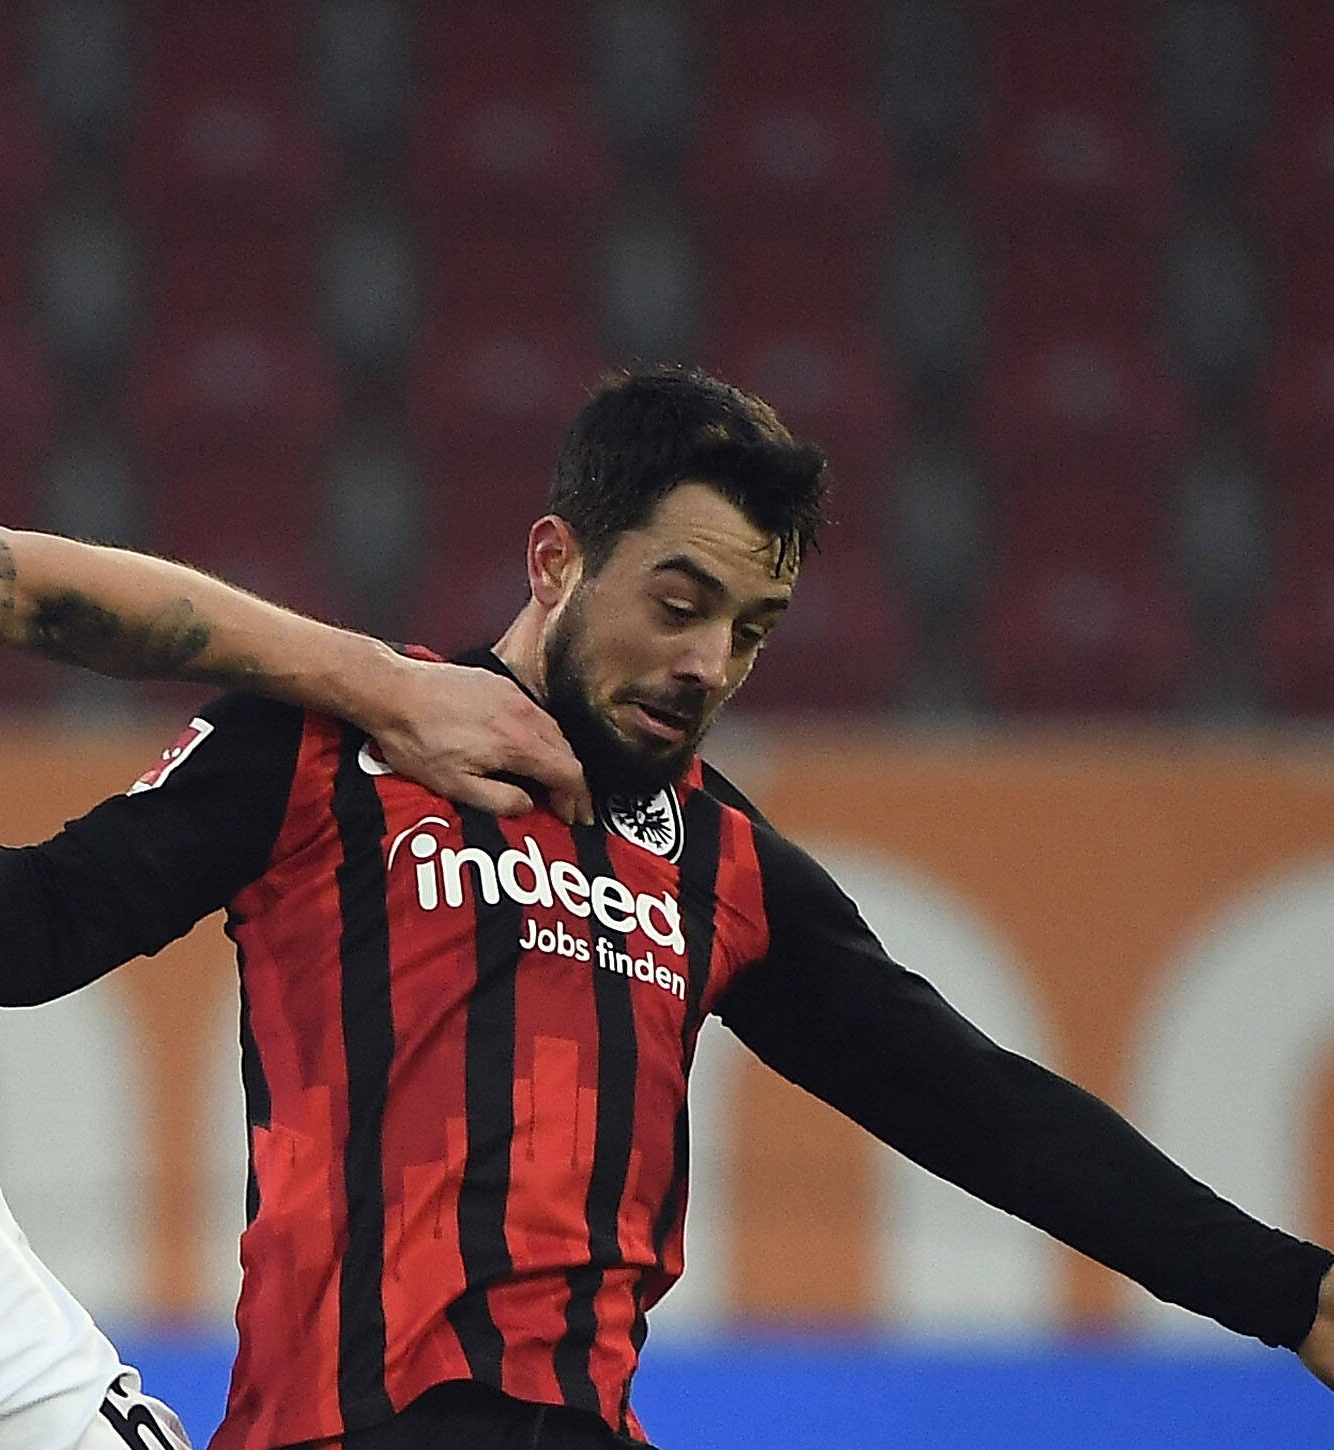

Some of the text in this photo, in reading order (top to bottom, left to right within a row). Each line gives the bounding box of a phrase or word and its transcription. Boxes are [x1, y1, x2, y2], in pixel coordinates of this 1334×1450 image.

[410, 832, 686, 956] indeed
[519, 918, 686, 1001] Jobs finden
